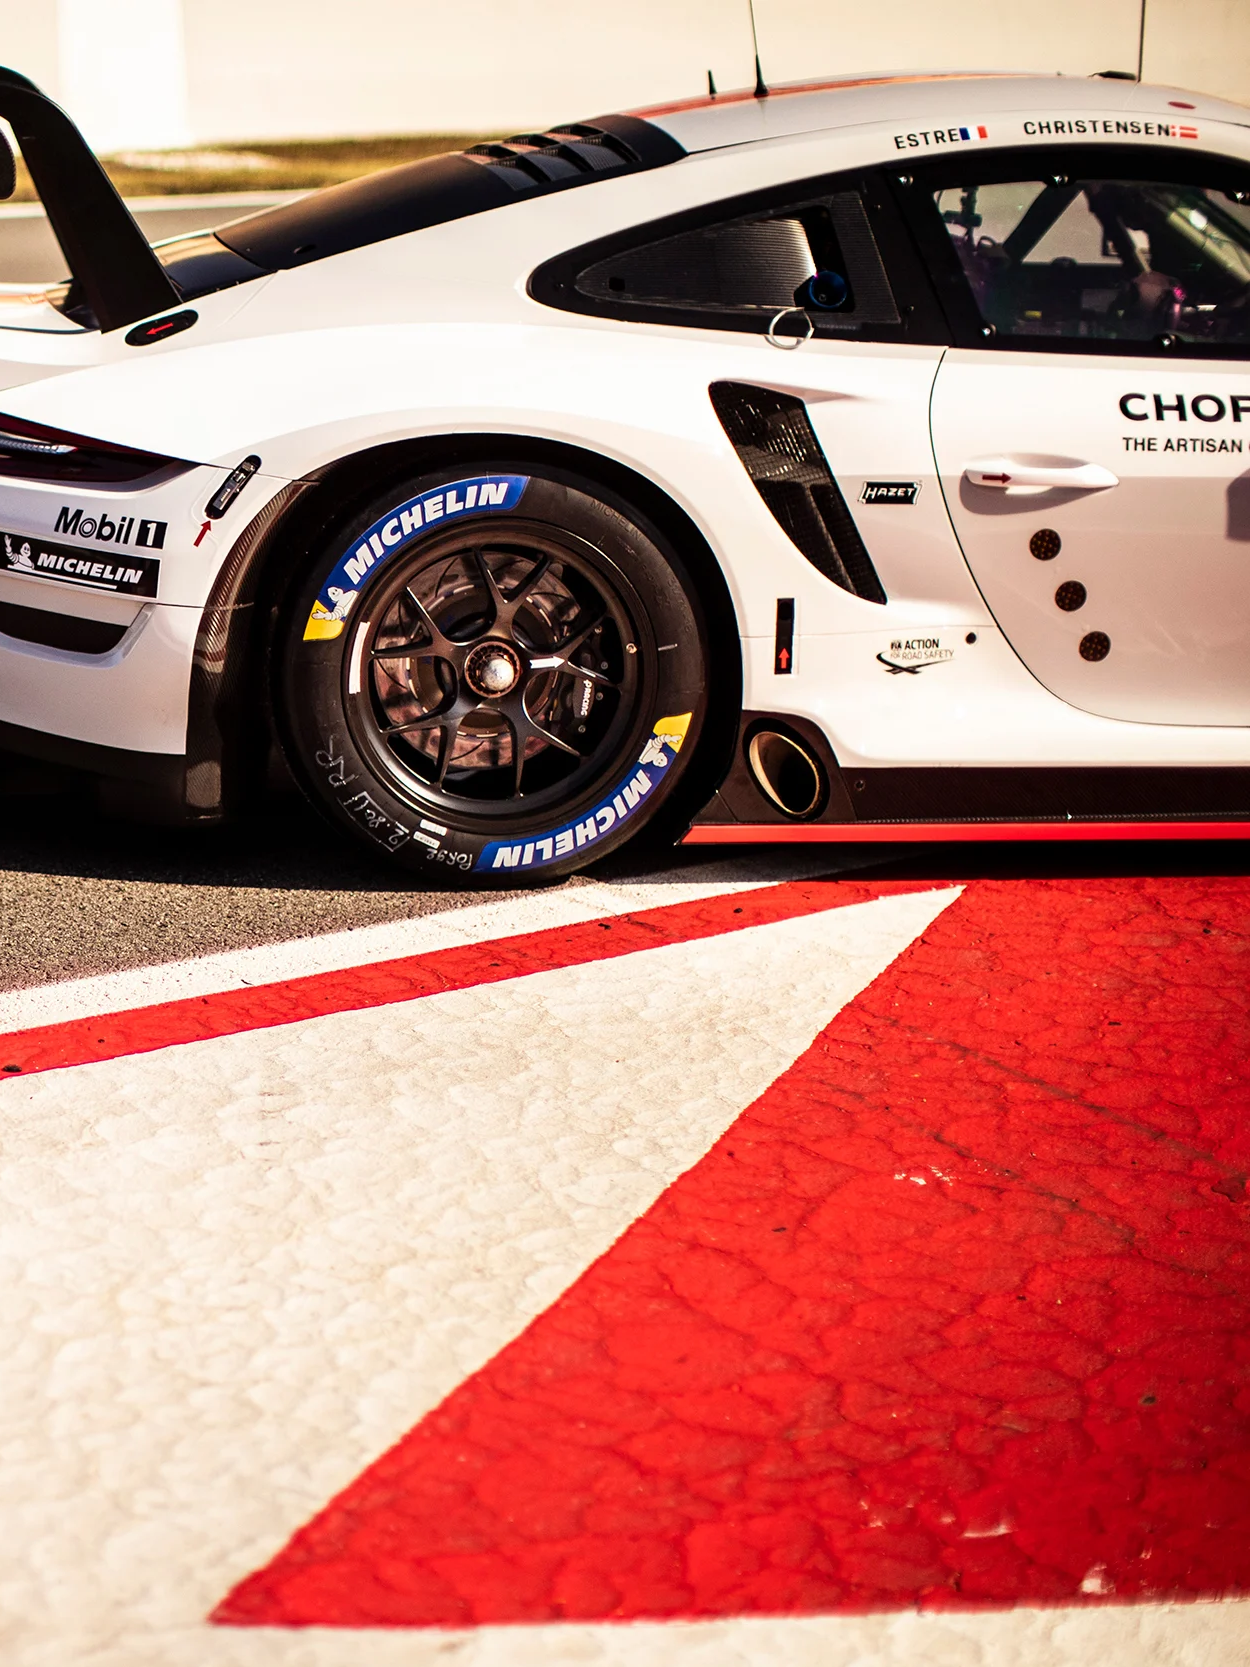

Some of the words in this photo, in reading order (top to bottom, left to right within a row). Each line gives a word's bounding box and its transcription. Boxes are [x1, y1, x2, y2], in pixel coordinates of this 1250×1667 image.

[1023, 120, 1170, 136] CHRISTENSEN
[894, 128, 959, 149] ESTRE
[1123, 437, 1158, 452] THE
[1163, 438, 1243, 453] ARTISAN
[865, 487, 915, 499] HAZET
[54, 506, 135, 545] Mobil
[343, 482, 508, 585] MICHELIN
[37, 553, 143, 584] MICHELIN
[905, 638, 940, 650] ACTION
[901, 650, 923, 660] ROAD
[924, 648, 954, 660] SAFETY
[492, 769, 652, 868] MICHELIN
